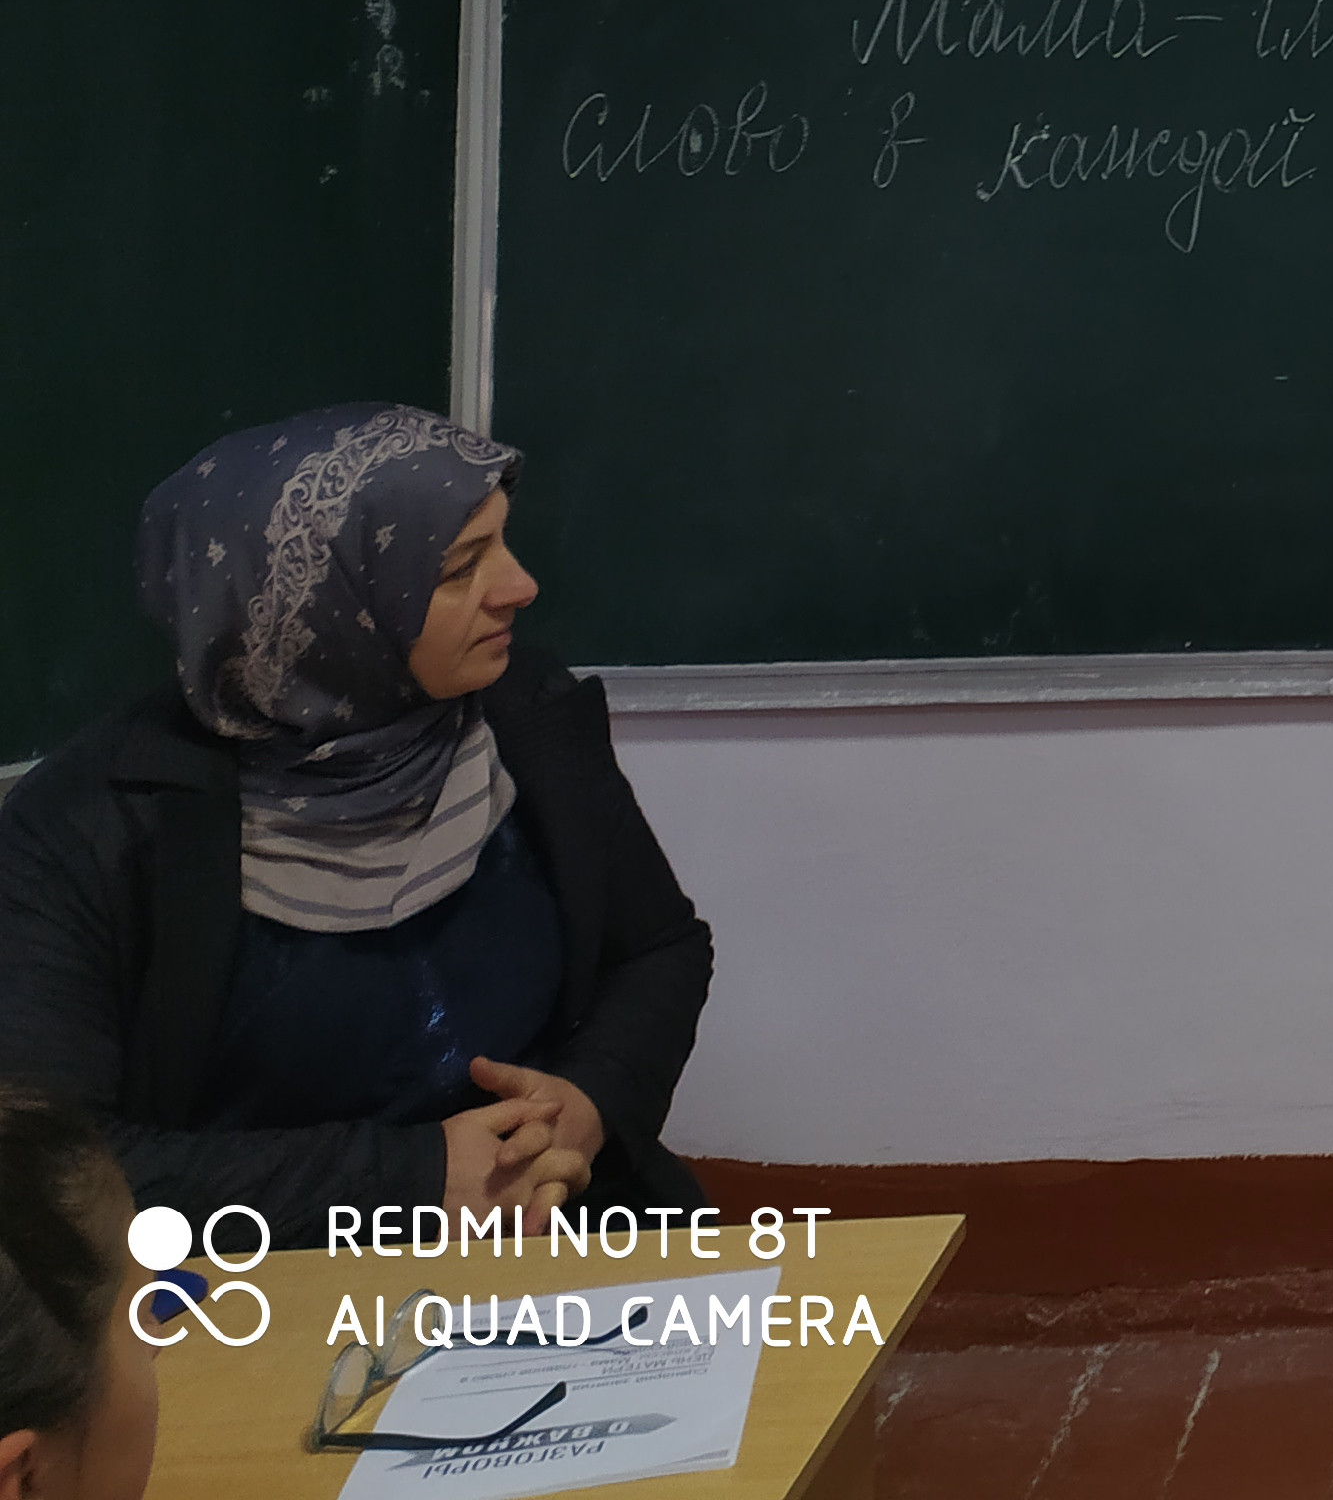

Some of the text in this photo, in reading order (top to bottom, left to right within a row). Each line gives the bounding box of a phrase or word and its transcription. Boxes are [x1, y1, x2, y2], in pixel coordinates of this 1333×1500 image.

[873, 91, 927, 188] в
[976, 107, 1317, 252] каждой
[422, 1440, 605, 1479] РАЗГОВОРЫ
